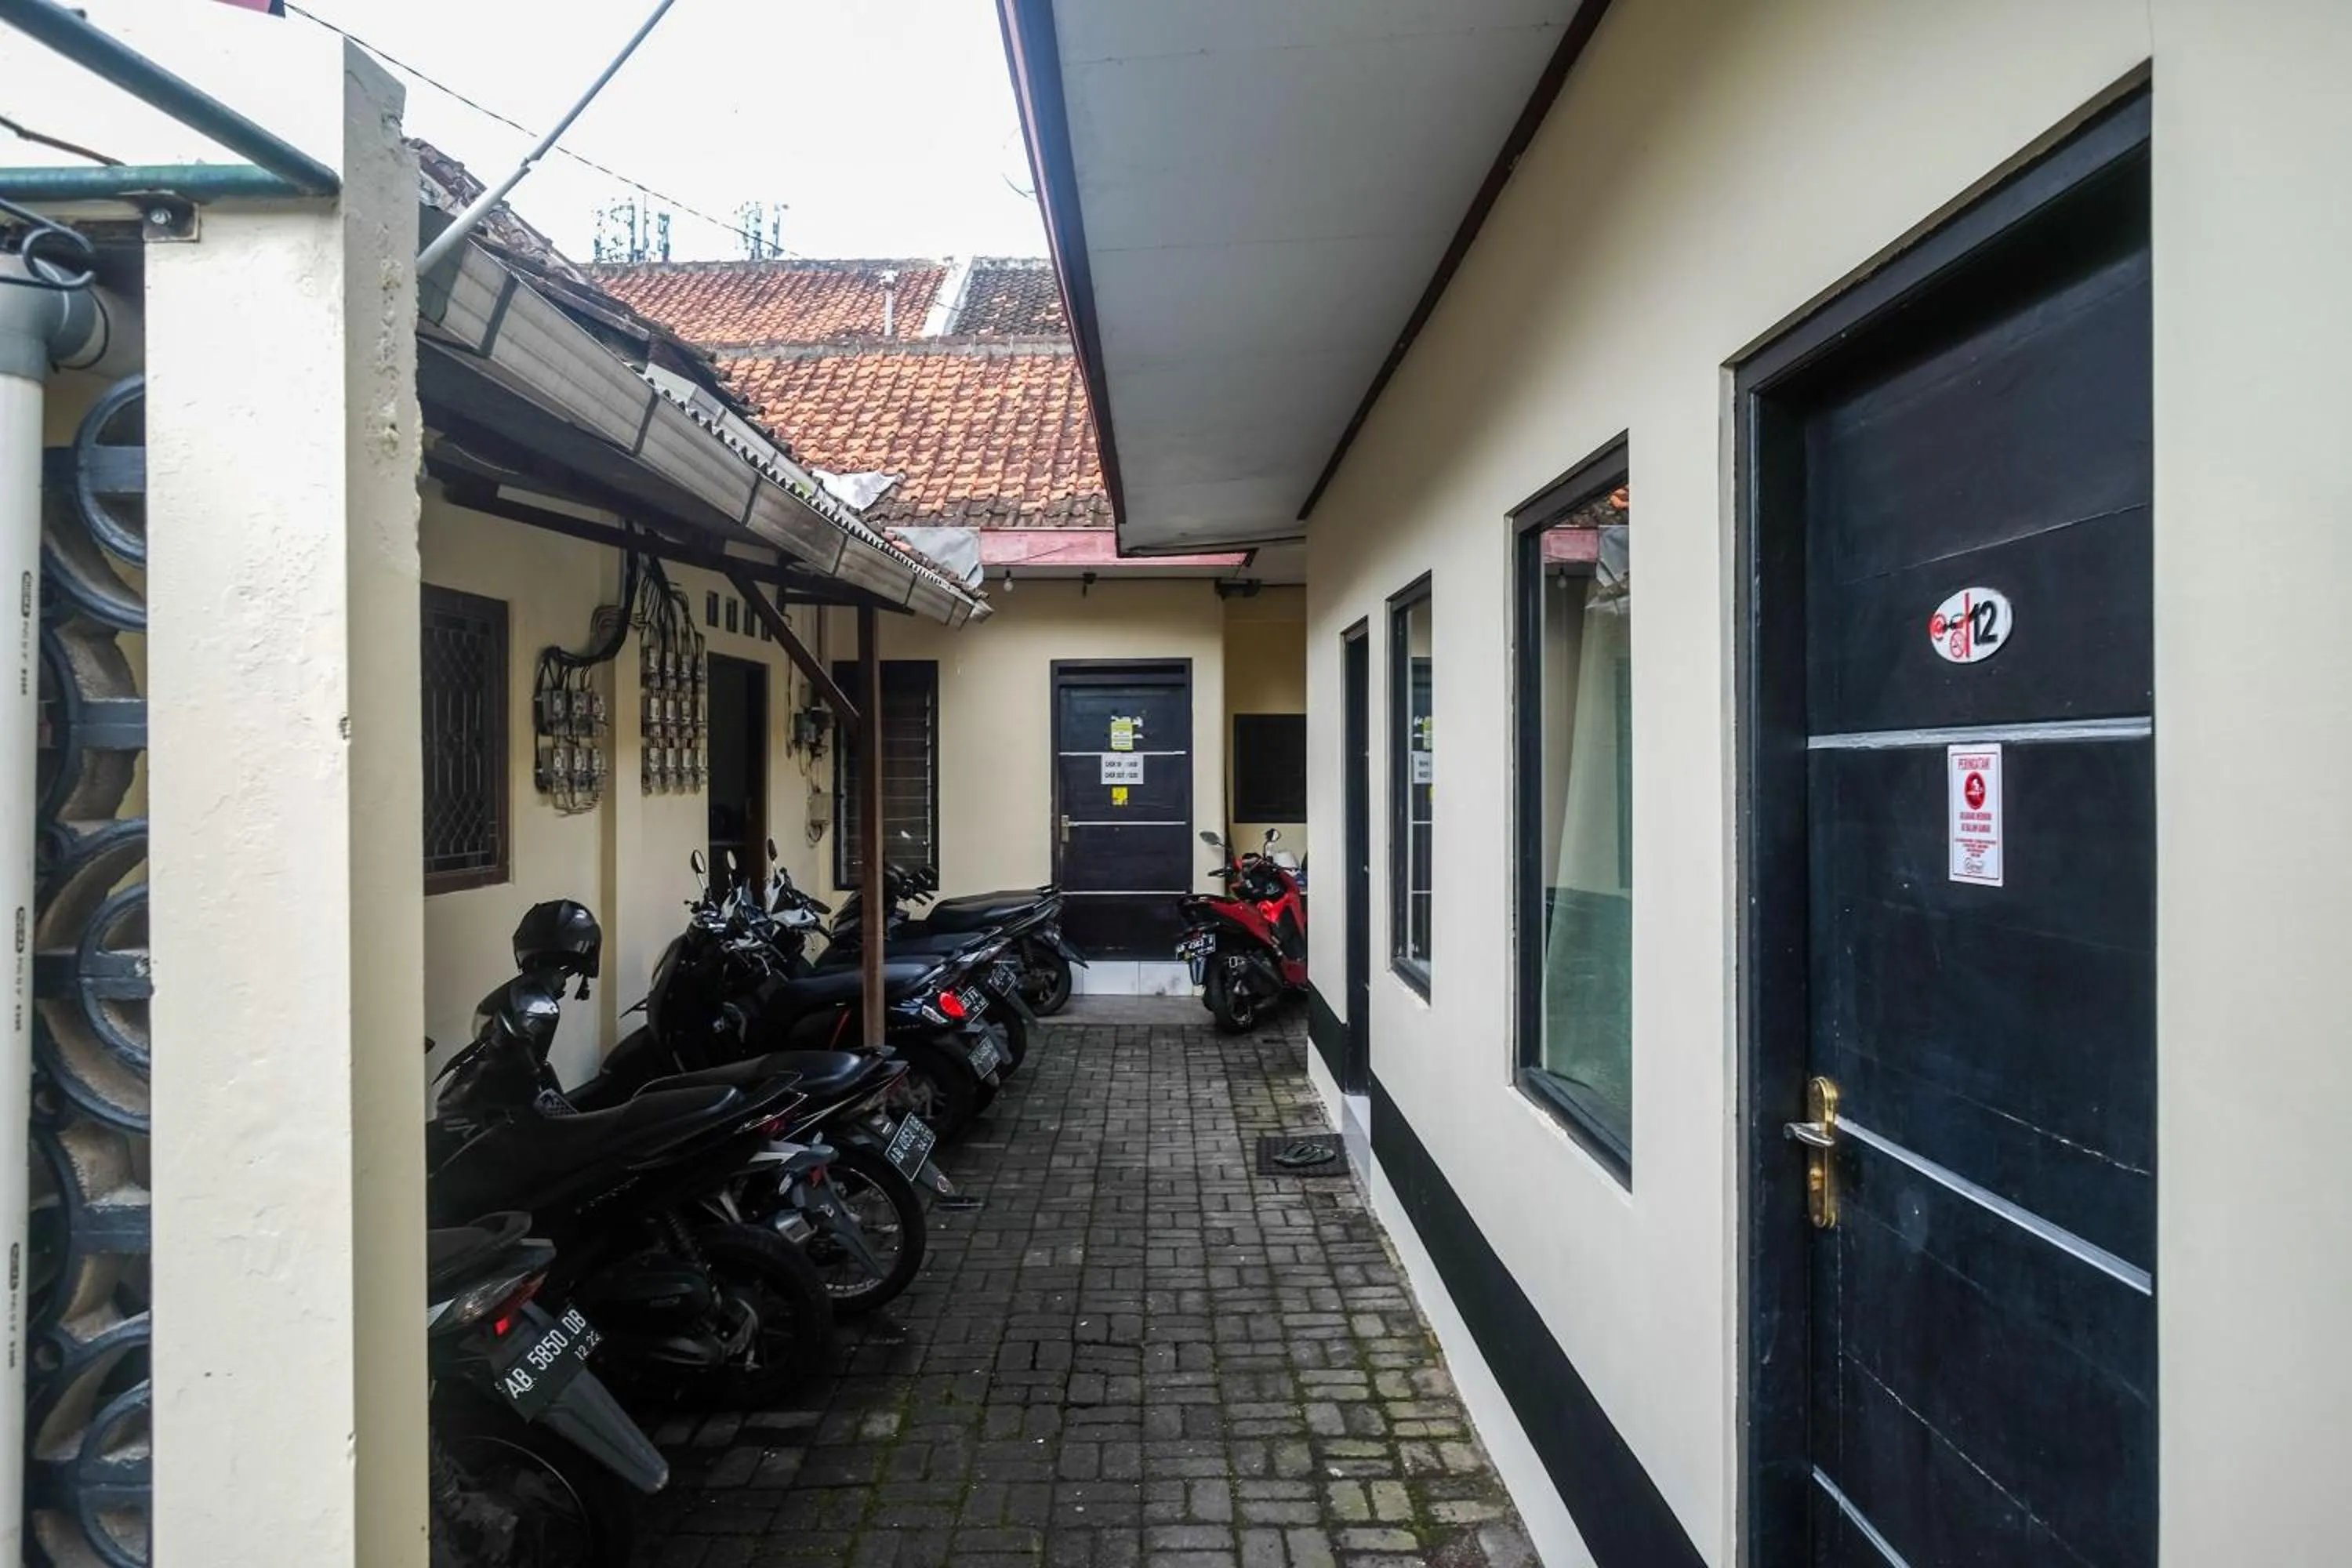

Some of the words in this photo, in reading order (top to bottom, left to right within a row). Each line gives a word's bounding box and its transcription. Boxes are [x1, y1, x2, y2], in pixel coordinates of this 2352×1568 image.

[1969, 601, 1998, 646] 12
[505, 1368, 533, 1399] AB
[527, 1329, 568, 1370] 5850
[561, 1308, 586, 1334] DB
